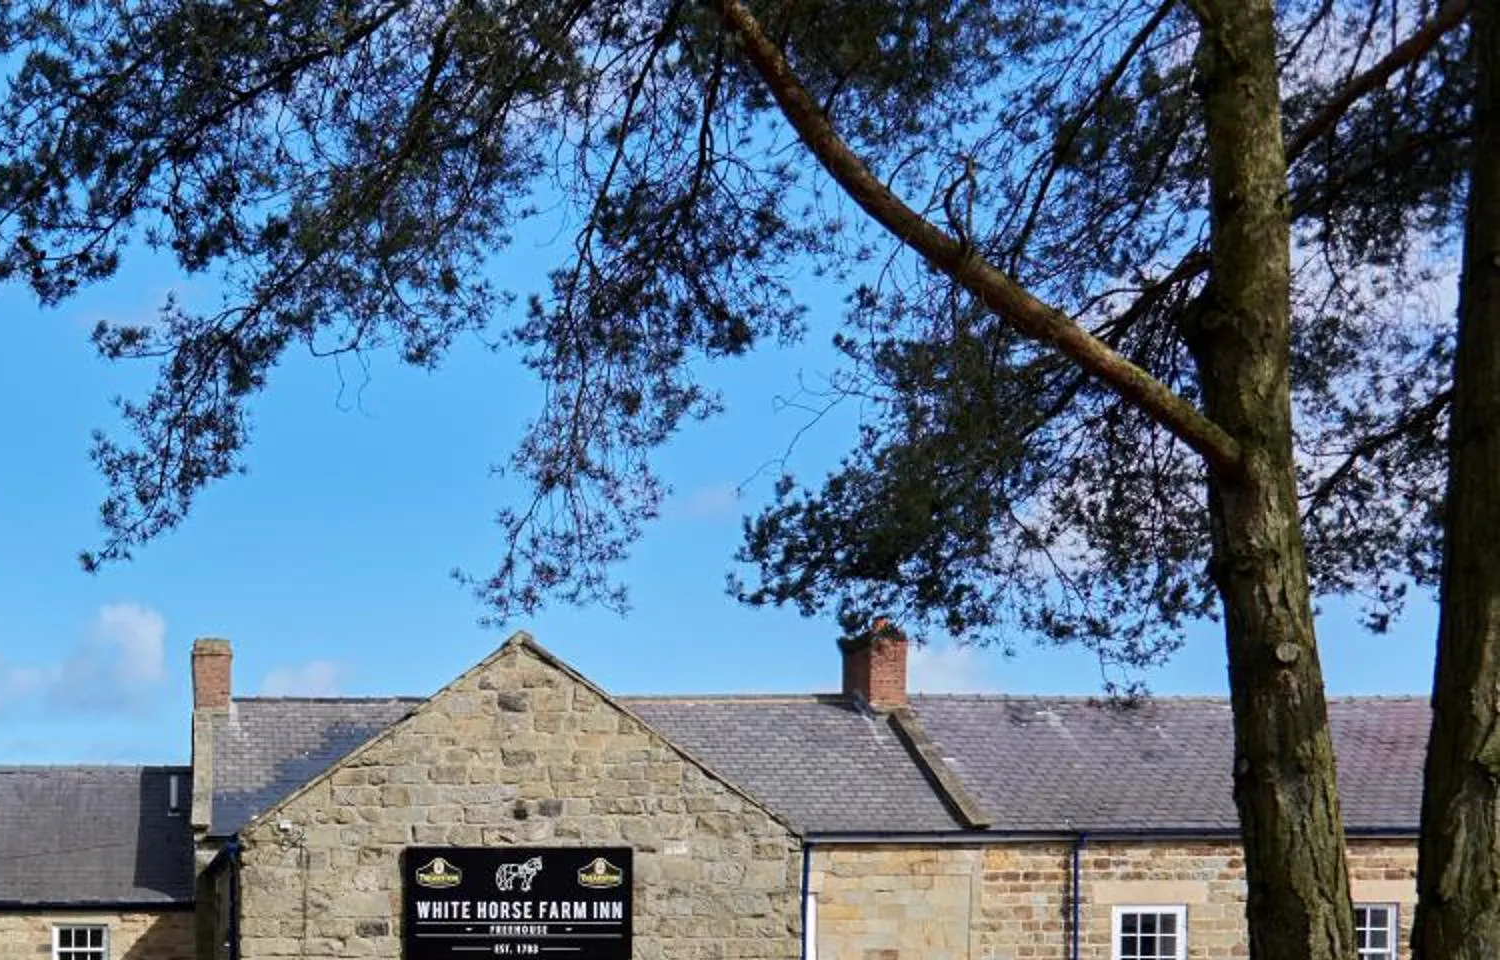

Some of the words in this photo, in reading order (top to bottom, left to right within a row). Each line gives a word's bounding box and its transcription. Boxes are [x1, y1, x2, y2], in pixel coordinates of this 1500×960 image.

[416, 901, 471, 919] WHITE
[477, 901, 532, 919] HORSE
[539, 901, 587, 919] FARM
[593, 901, 623, 919] INN
